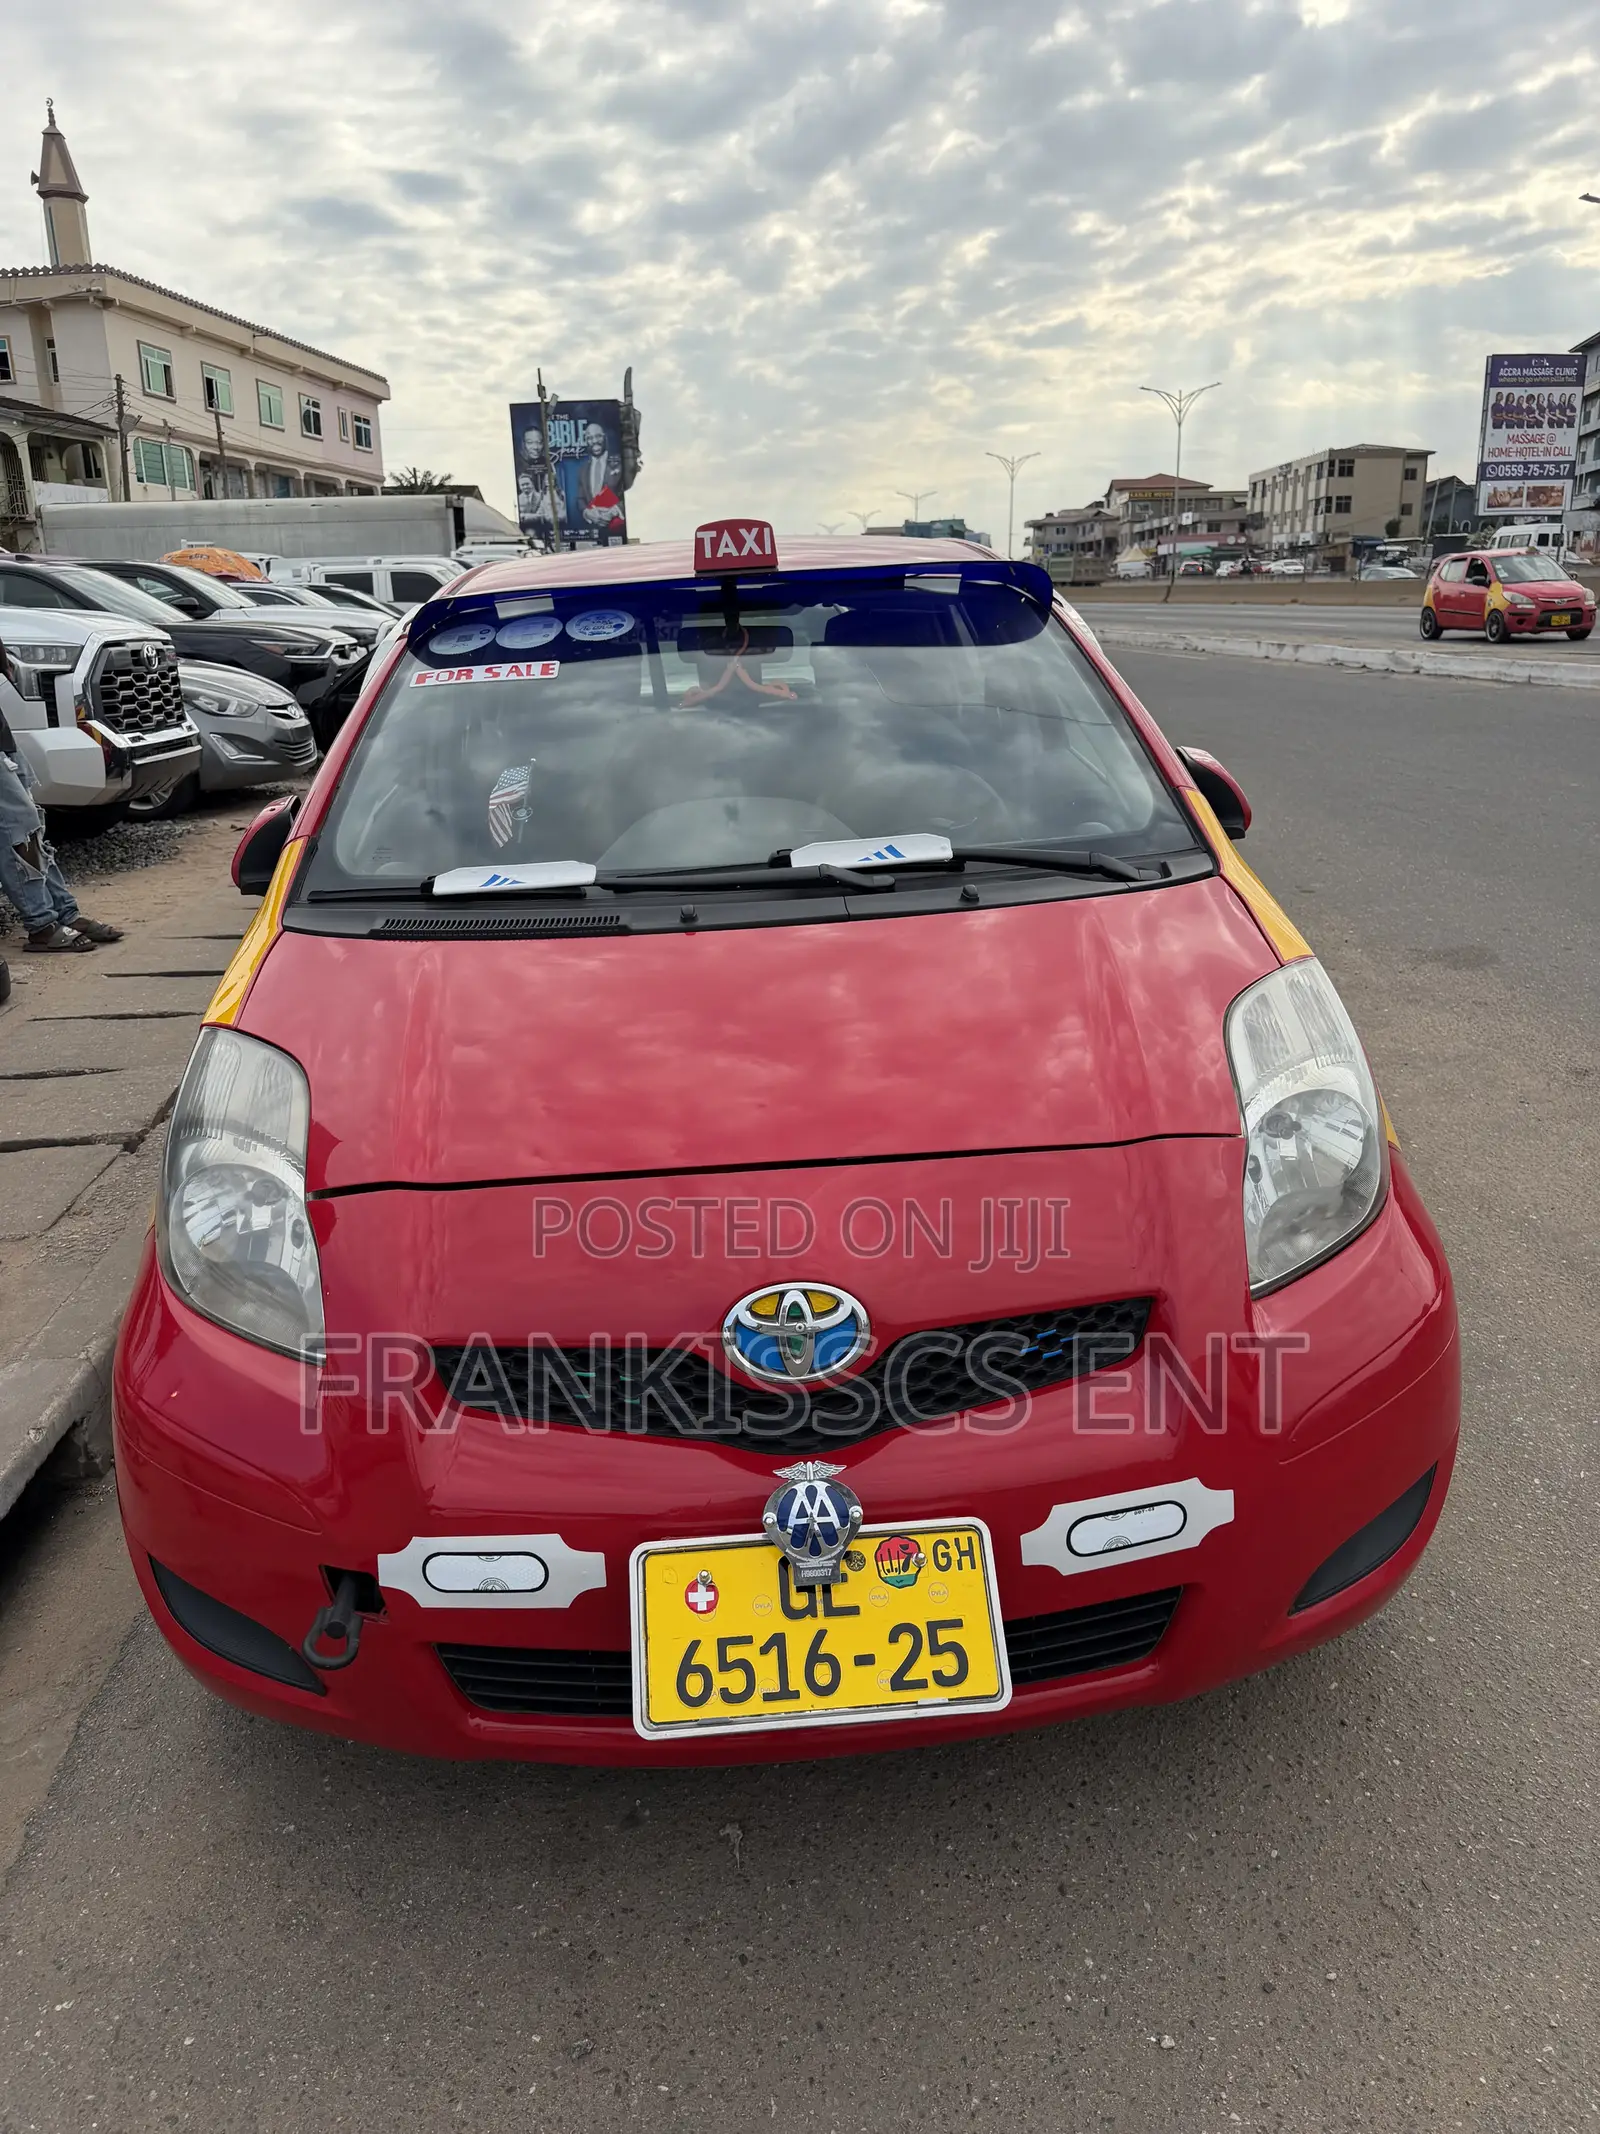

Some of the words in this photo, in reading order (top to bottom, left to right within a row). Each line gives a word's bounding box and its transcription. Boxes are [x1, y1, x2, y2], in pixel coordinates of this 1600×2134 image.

[1499, 368, 1521, 376] ACCRA
[1522, 367, 1554, 376] MASSAGE
[1555, 367, 1578, 375] CLINIC
[547, 419, 588, 448] BIBLE
[1507, 433, 1546, 445] MASSAGE
[1547, 433, 1557, 445] @
[1553, 446, 1572, 457] CALL
[1498, 464, 1570, 477] 0559-75-75-17
[696, 527, 772, 559] TAXI
[414, 667, 474, 685] FOR
[484, 662, 556, 679] SALE
[932, 1536, 976, 1572] GH
[675, 1619, 969, 1708] 6516-25
